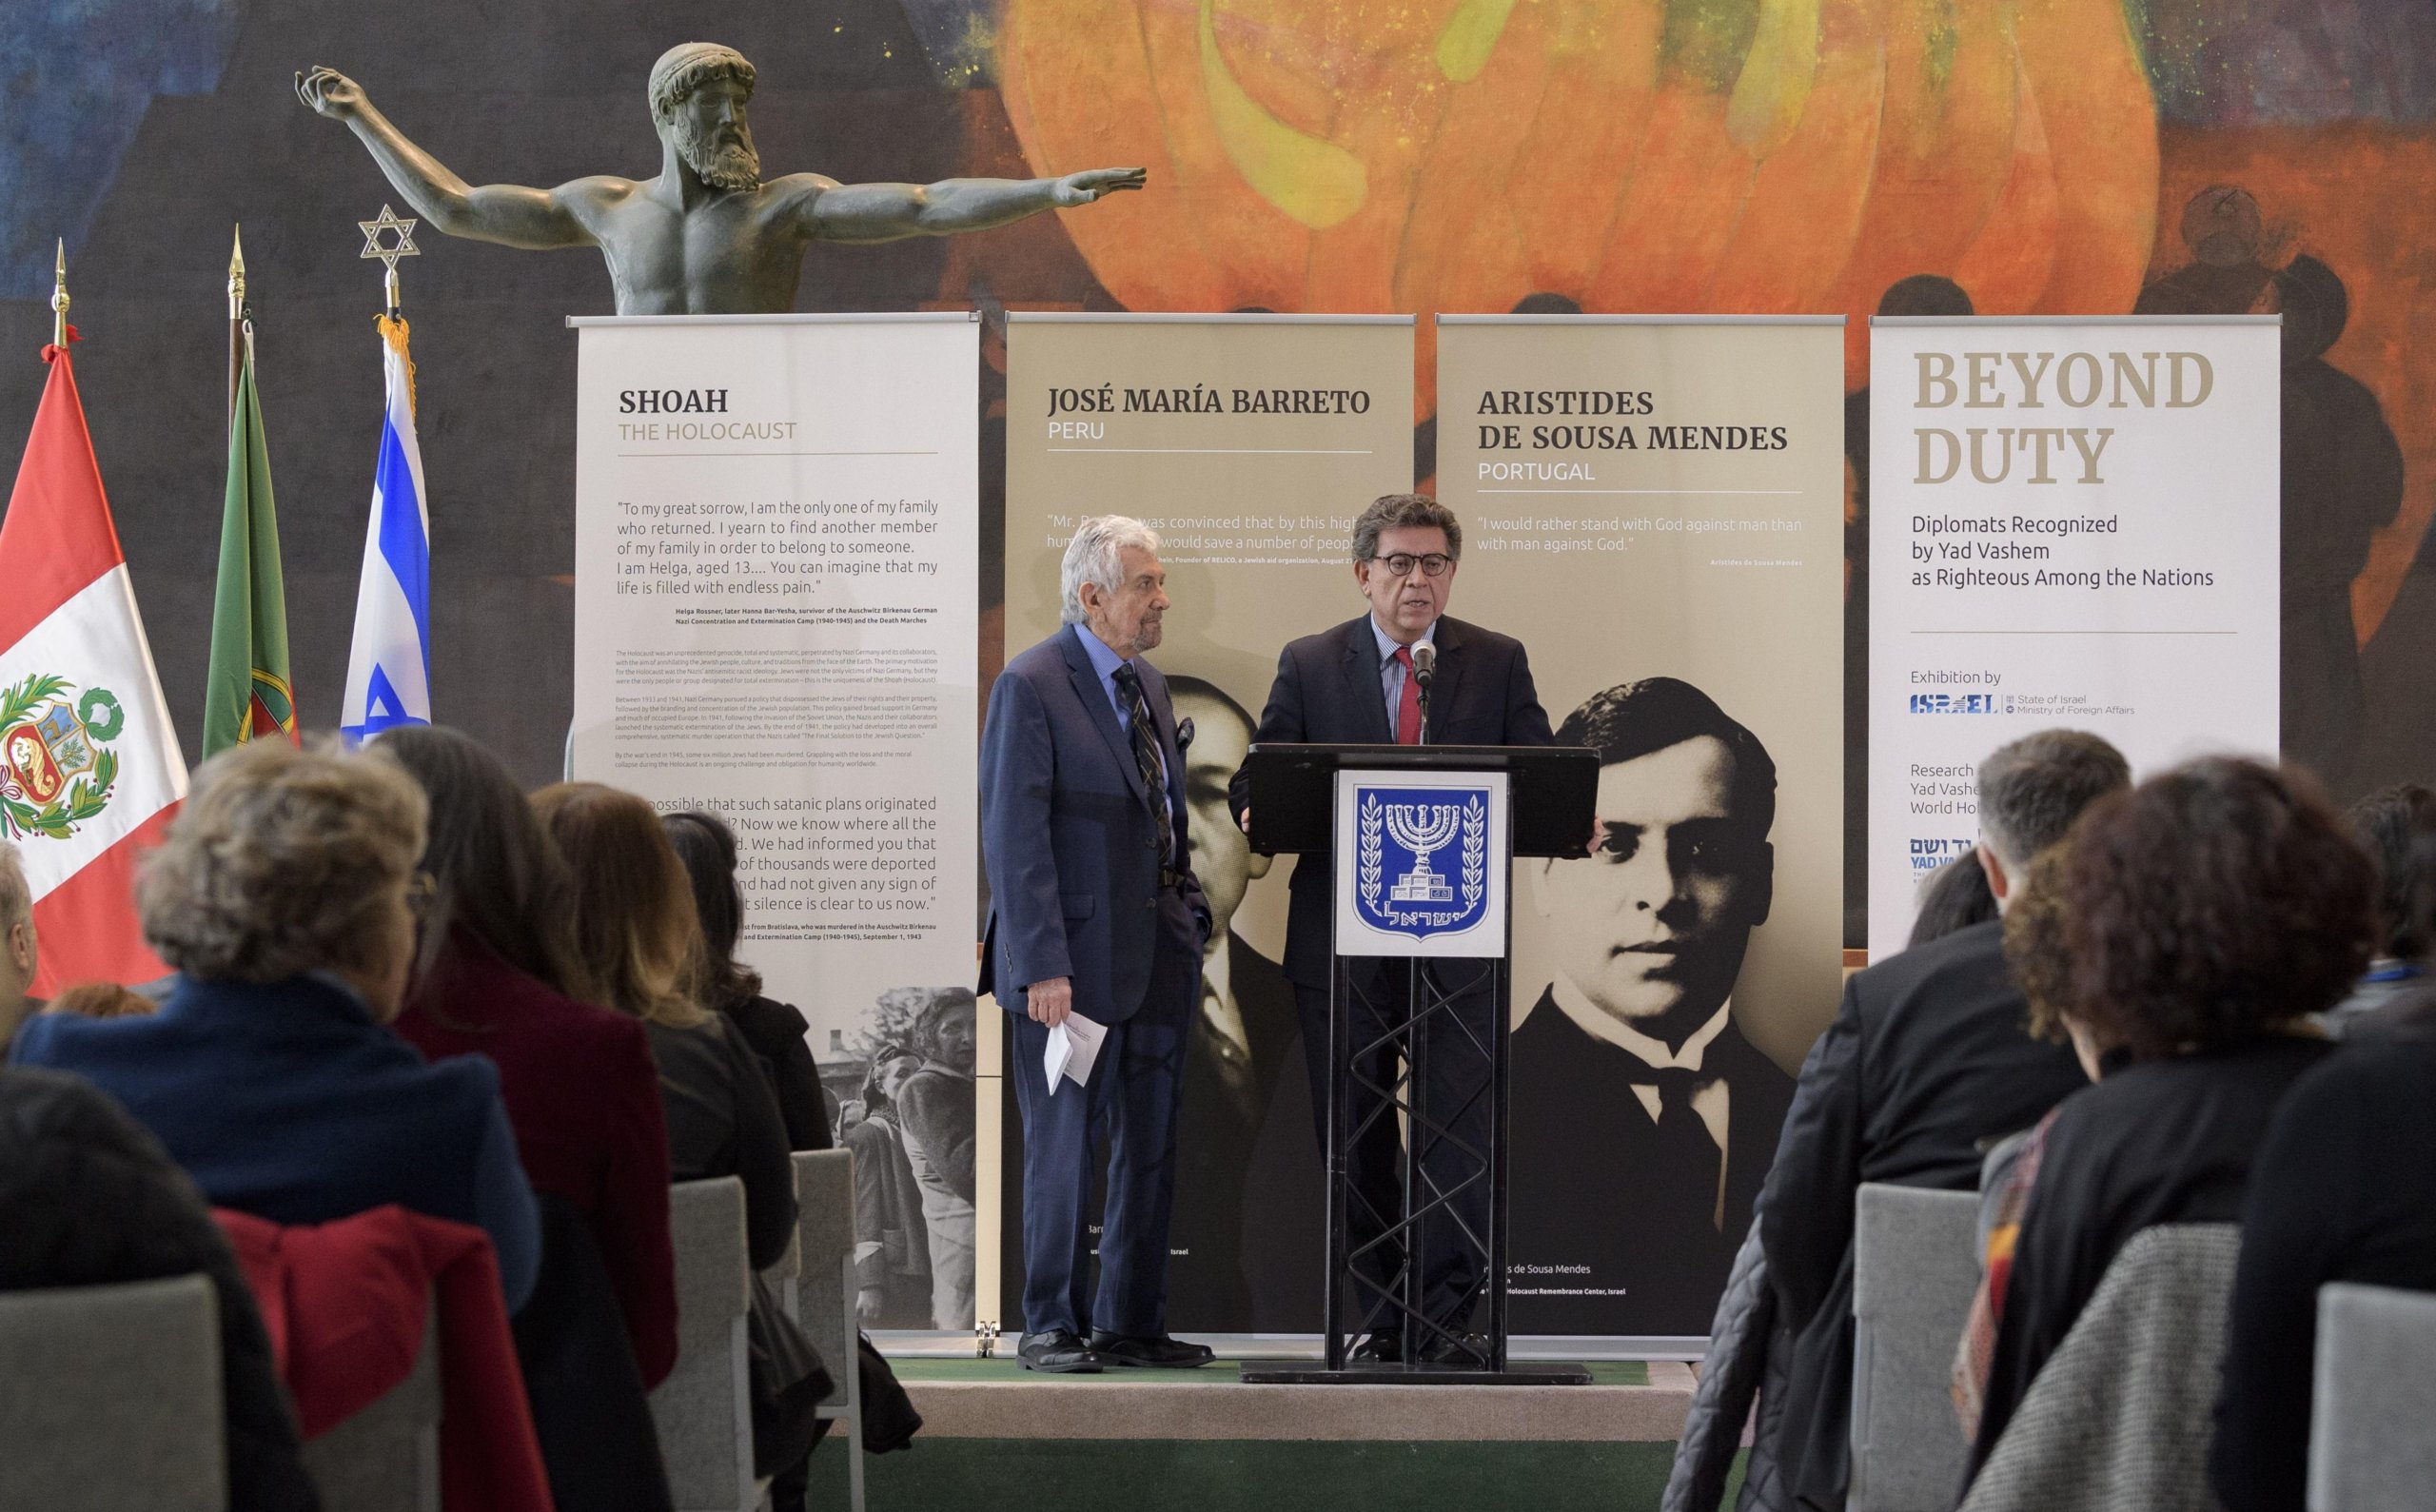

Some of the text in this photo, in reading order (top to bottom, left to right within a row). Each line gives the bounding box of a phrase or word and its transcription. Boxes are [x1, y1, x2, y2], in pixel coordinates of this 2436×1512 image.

[1913, 351, 2213, 408] BEYOND
[619, 389, 728, 413] SHOAH
[1047, 382, 1369, 418] JOSÉ MARÍA BARRETO
[1476, 390, 1653, 415] ARISTIDES
[618, 422, 797, 441] THE HOLOCAUST
[1049, 422, 1104, 439] PERU
[1478, 425, 1787, 450] DE SOUSA MENDES
[1913, 427, 2114, 484] DUTY
[1479, 462, 1596, 480] PORTUGAL
[618, 499, 937, 518] "To my great sorrow, I am the only one of my family
[617, 519, 938, 537] who returned. I yearn to find another member
[1048, 515, 1075, 528] “Mr.
[1169, 515, 1240, 529] convinced
[1245, 515, 1274, 529] that
[1279, 516, 1295, 532] by
[1300, 516, 1326, 529] this
[1477, 517, 1802, 534] "I would rather stand with God against man than
[1913, 514, 2116, 537] Diplomats Recognized
[617, 540, 914, 558] of my family in order to belong to someone.
[1160, 534, 1314, 549] would save a number of
[1477, 537, 1634, 554] with man against God."
[1913, 540, 2049, 563] by Yad Vashem
[617, 559, 937, 577] I am Helga, aged 13.... You can imagine that my
[1912, 567, 2213, 589] as Righteous Among the Nations
[617, 579, 820, 596] life is filled with endless pain."
[1911, 670, 2001, 686] Exhibition by
[1910, 694, 1997, 713] ISRAEL
[2017, 695, 2086, 704] State of Israel
[2017, 705, 2135, 716] Ministry of Foreign Affairs
[1911, 763, 1974, 776] Research
[1910, 782, 1979, 796] Yad Vashe
[705, 796, 935, 813] that such satanic plans originated
[1910, 800, 1952, 814] World
[738, 856, 935, 873] of thousands were deported
[1911, 856, 1936, 869] YAD
[754, 896, 935, 911] silence is clear to us now."
[1384, 901, 1460, 926] ישראל
[1513, 1264, 1590, 1273] de Sousa Mendes
